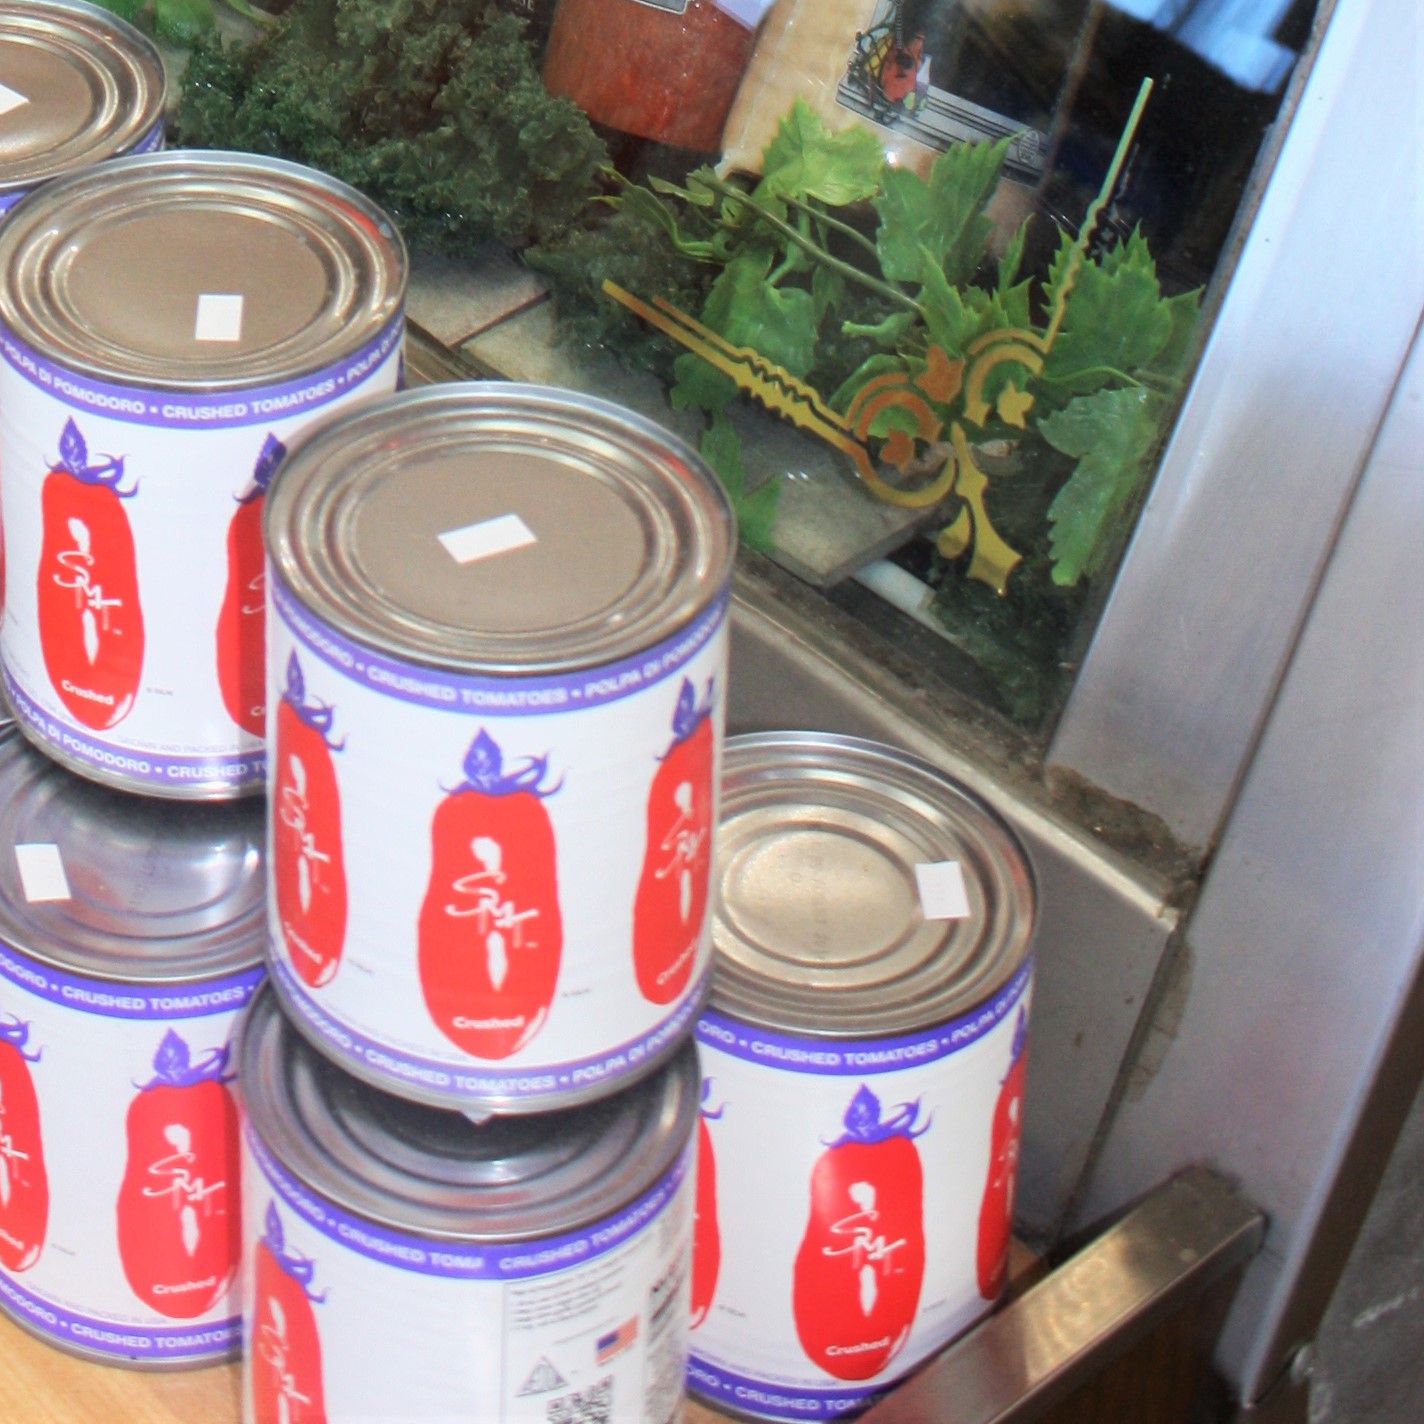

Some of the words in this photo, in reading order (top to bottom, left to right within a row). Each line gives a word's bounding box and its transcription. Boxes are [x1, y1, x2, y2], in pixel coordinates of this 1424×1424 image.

[53, 376, 146, 416] POMODORO
[161, 402, 247, 421] CRUSHED
[250, 378, 336, 416] TOMATOES
[365, 663, 456, 705] CRUSHED
[459, 684, 570, 709] TOMATOES
[583, 663, 644, 702] POLPA
[61, 731, 151, 774] POMODORO
[166, 764, 248, 779] CRUSHED
[451, 1014, 525, 1032] Crushed
[750, 1037, 838, 1067] CRUSHED
[842, 1037, 939, 1068] TOMATOES
[454, 1074, 557, 1093] TOMATOES
